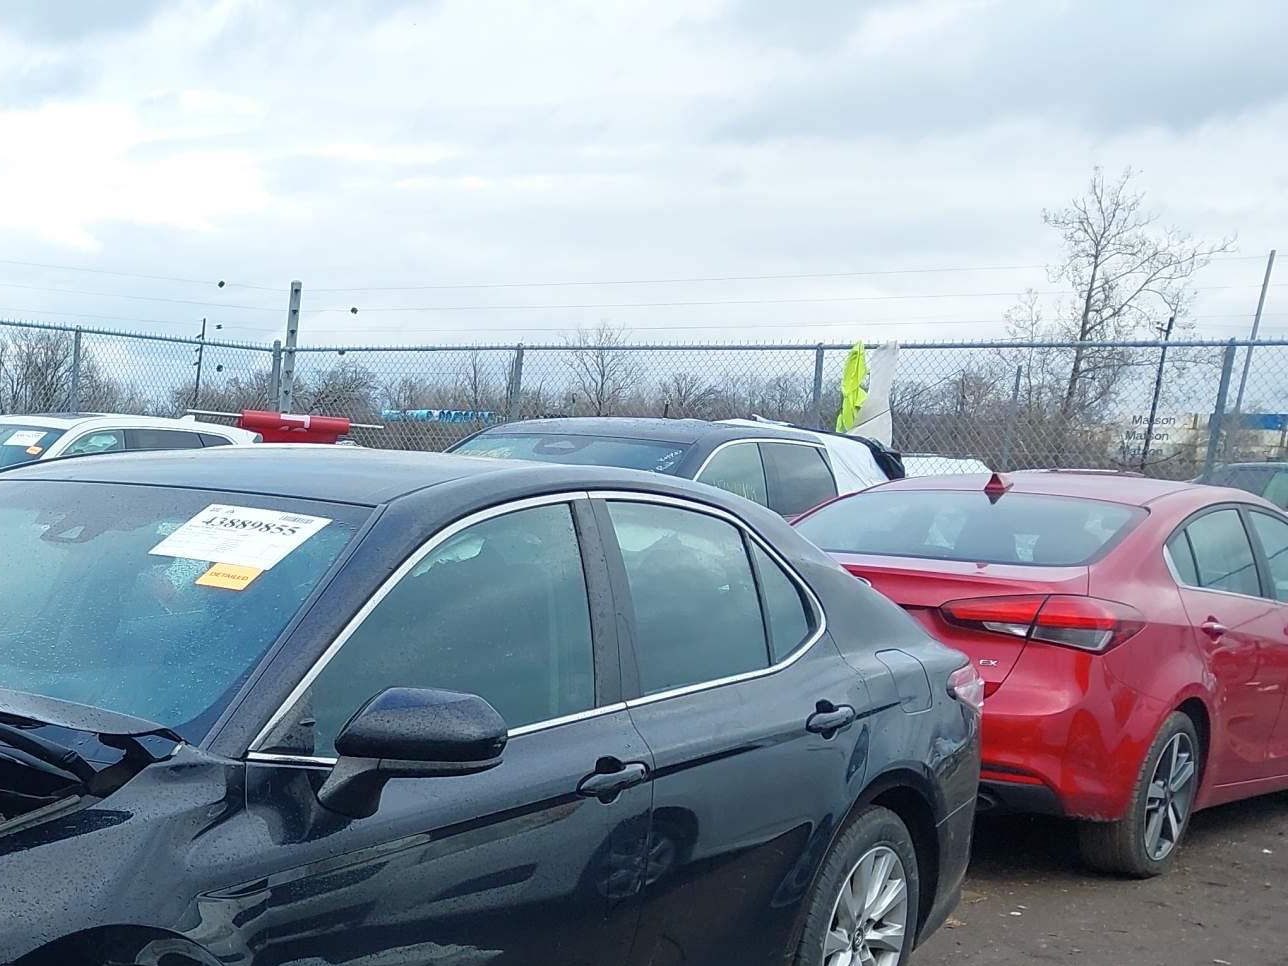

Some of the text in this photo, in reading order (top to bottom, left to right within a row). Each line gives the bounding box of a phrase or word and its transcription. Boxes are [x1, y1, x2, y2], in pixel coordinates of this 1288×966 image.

[1132, 415, 1176, 425] Mason
[202, 515, 300, 536] 43889855
[209, 571, 249, 581] DETAILED
[979, 659, 999, 667] EX
